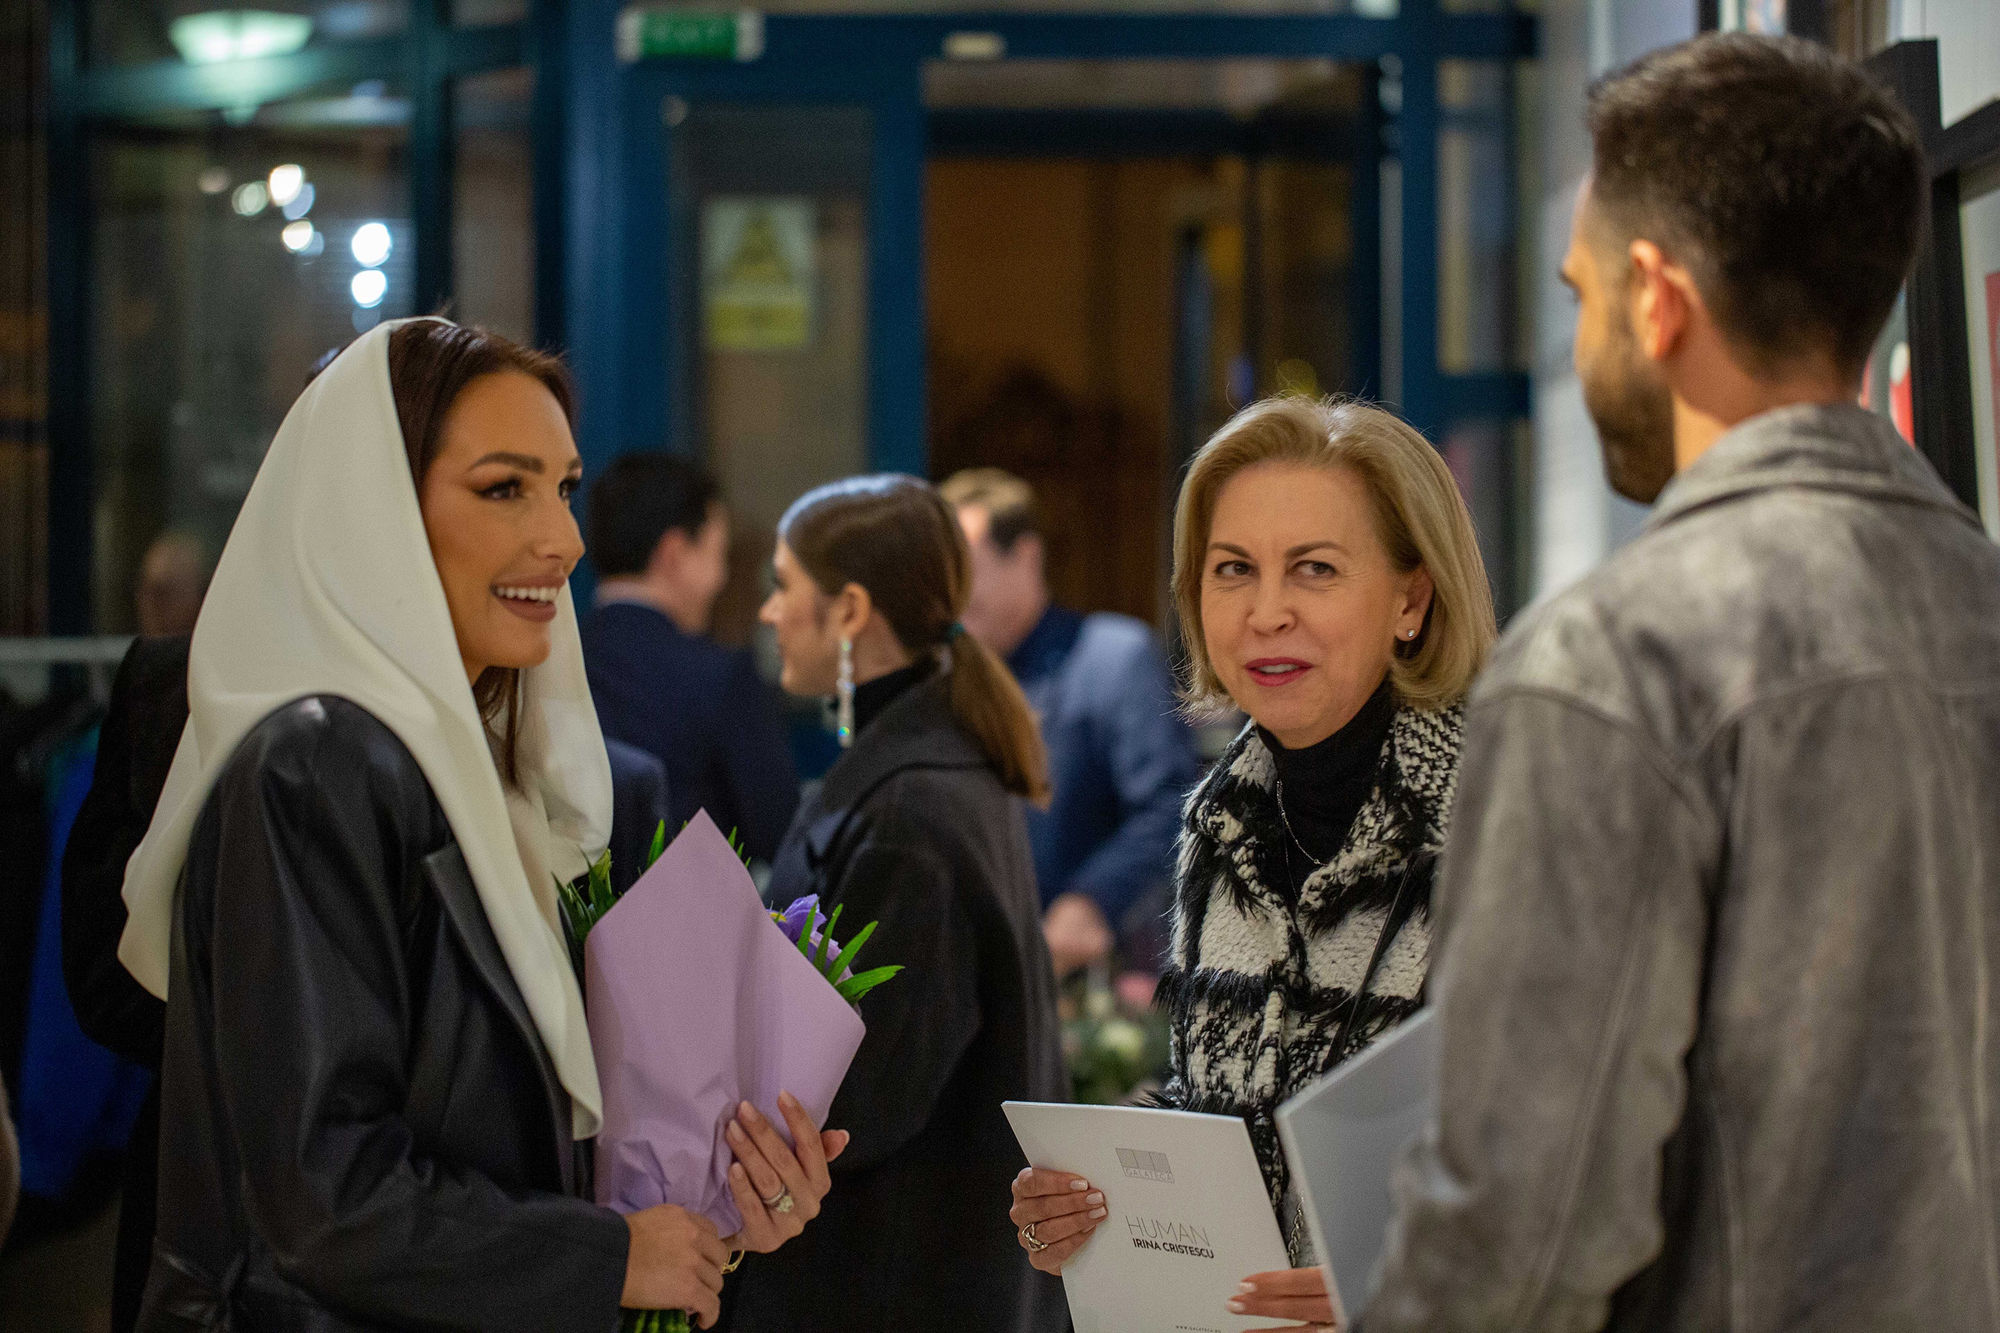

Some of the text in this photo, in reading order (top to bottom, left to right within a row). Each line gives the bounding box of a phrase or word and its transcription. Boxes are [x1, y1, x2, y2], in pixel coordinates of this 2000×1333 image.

[1125, 1215, 1210, 1247] HUMAN
[1132, 1238, 1214, 1259] IRINA CRISTESCU
